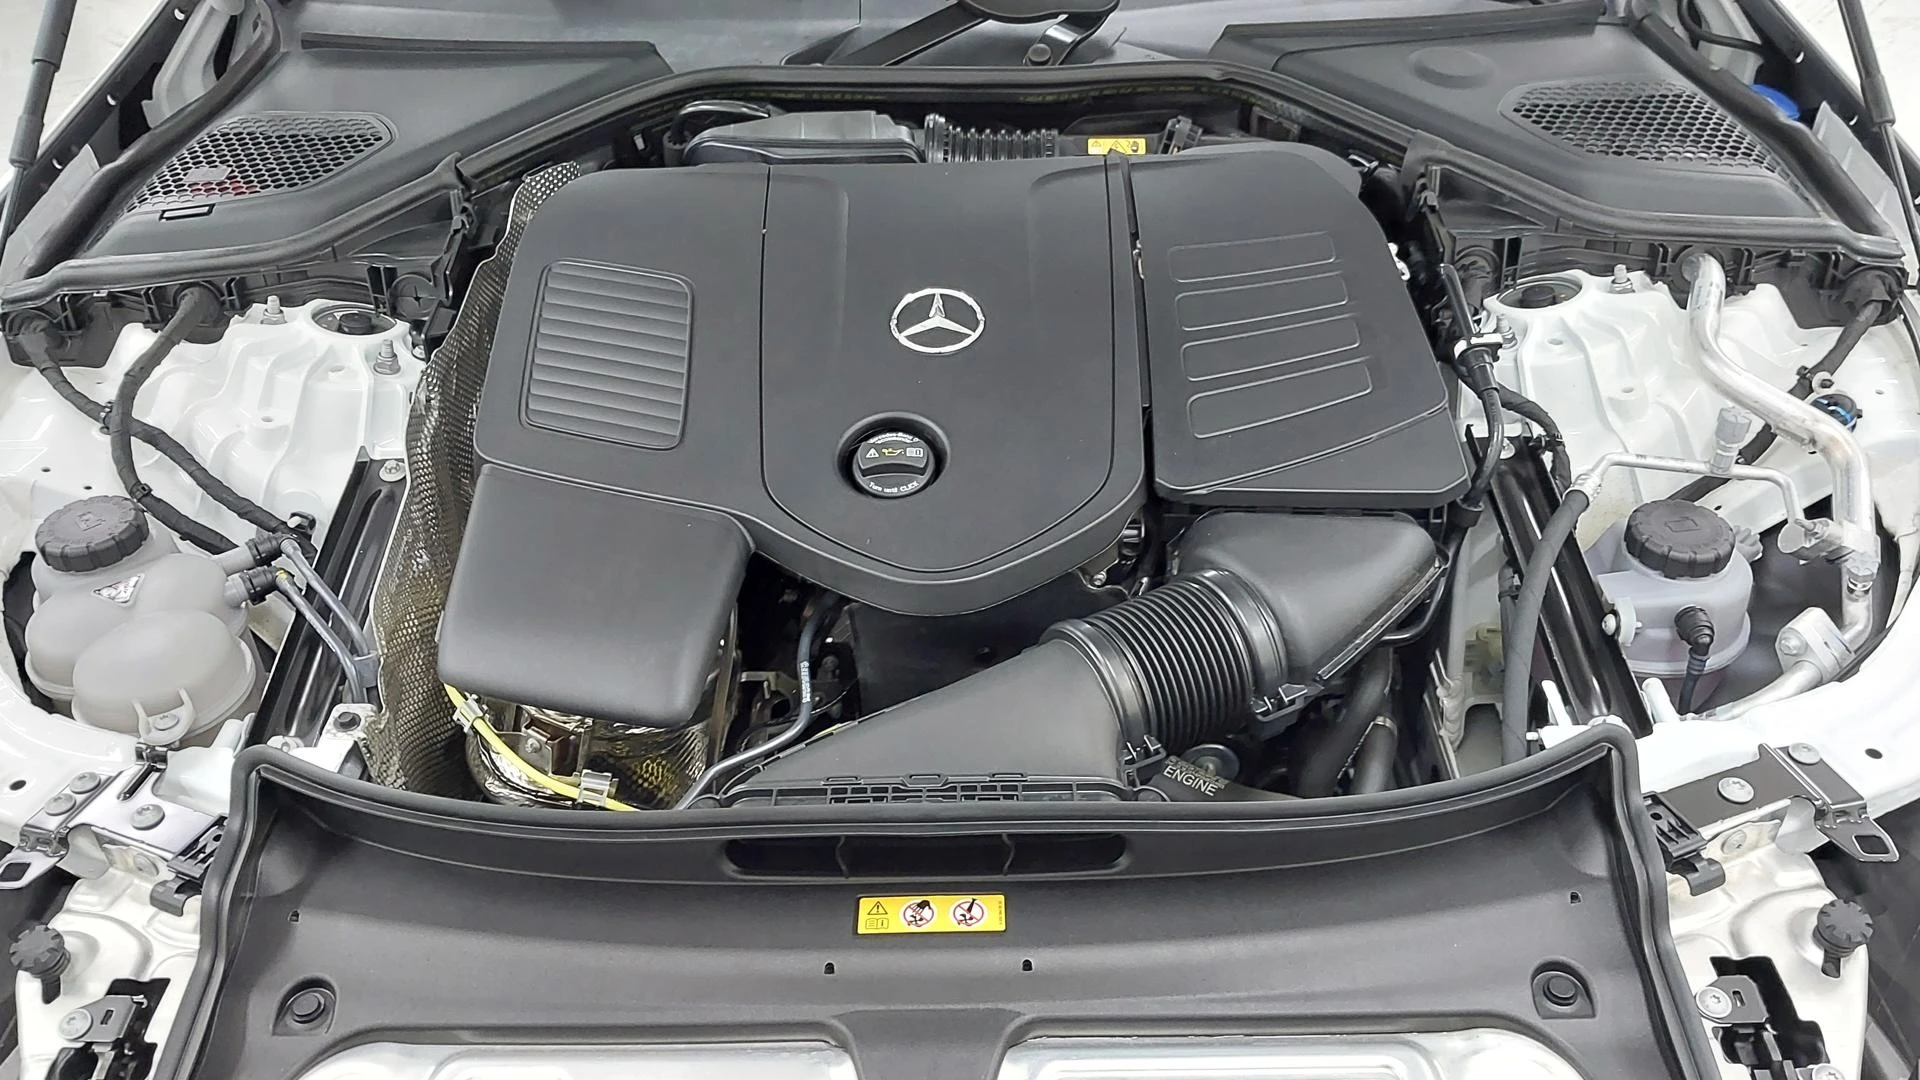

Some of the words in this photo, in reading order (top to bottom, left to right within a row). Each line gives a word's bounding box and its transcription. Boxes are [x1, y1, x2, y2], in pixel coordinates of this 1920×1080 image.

[869, 482, 882, 491] Turn
[900, 481, 919, 491] CLICK
[1163, 765, 1218, 796] ENGINE
